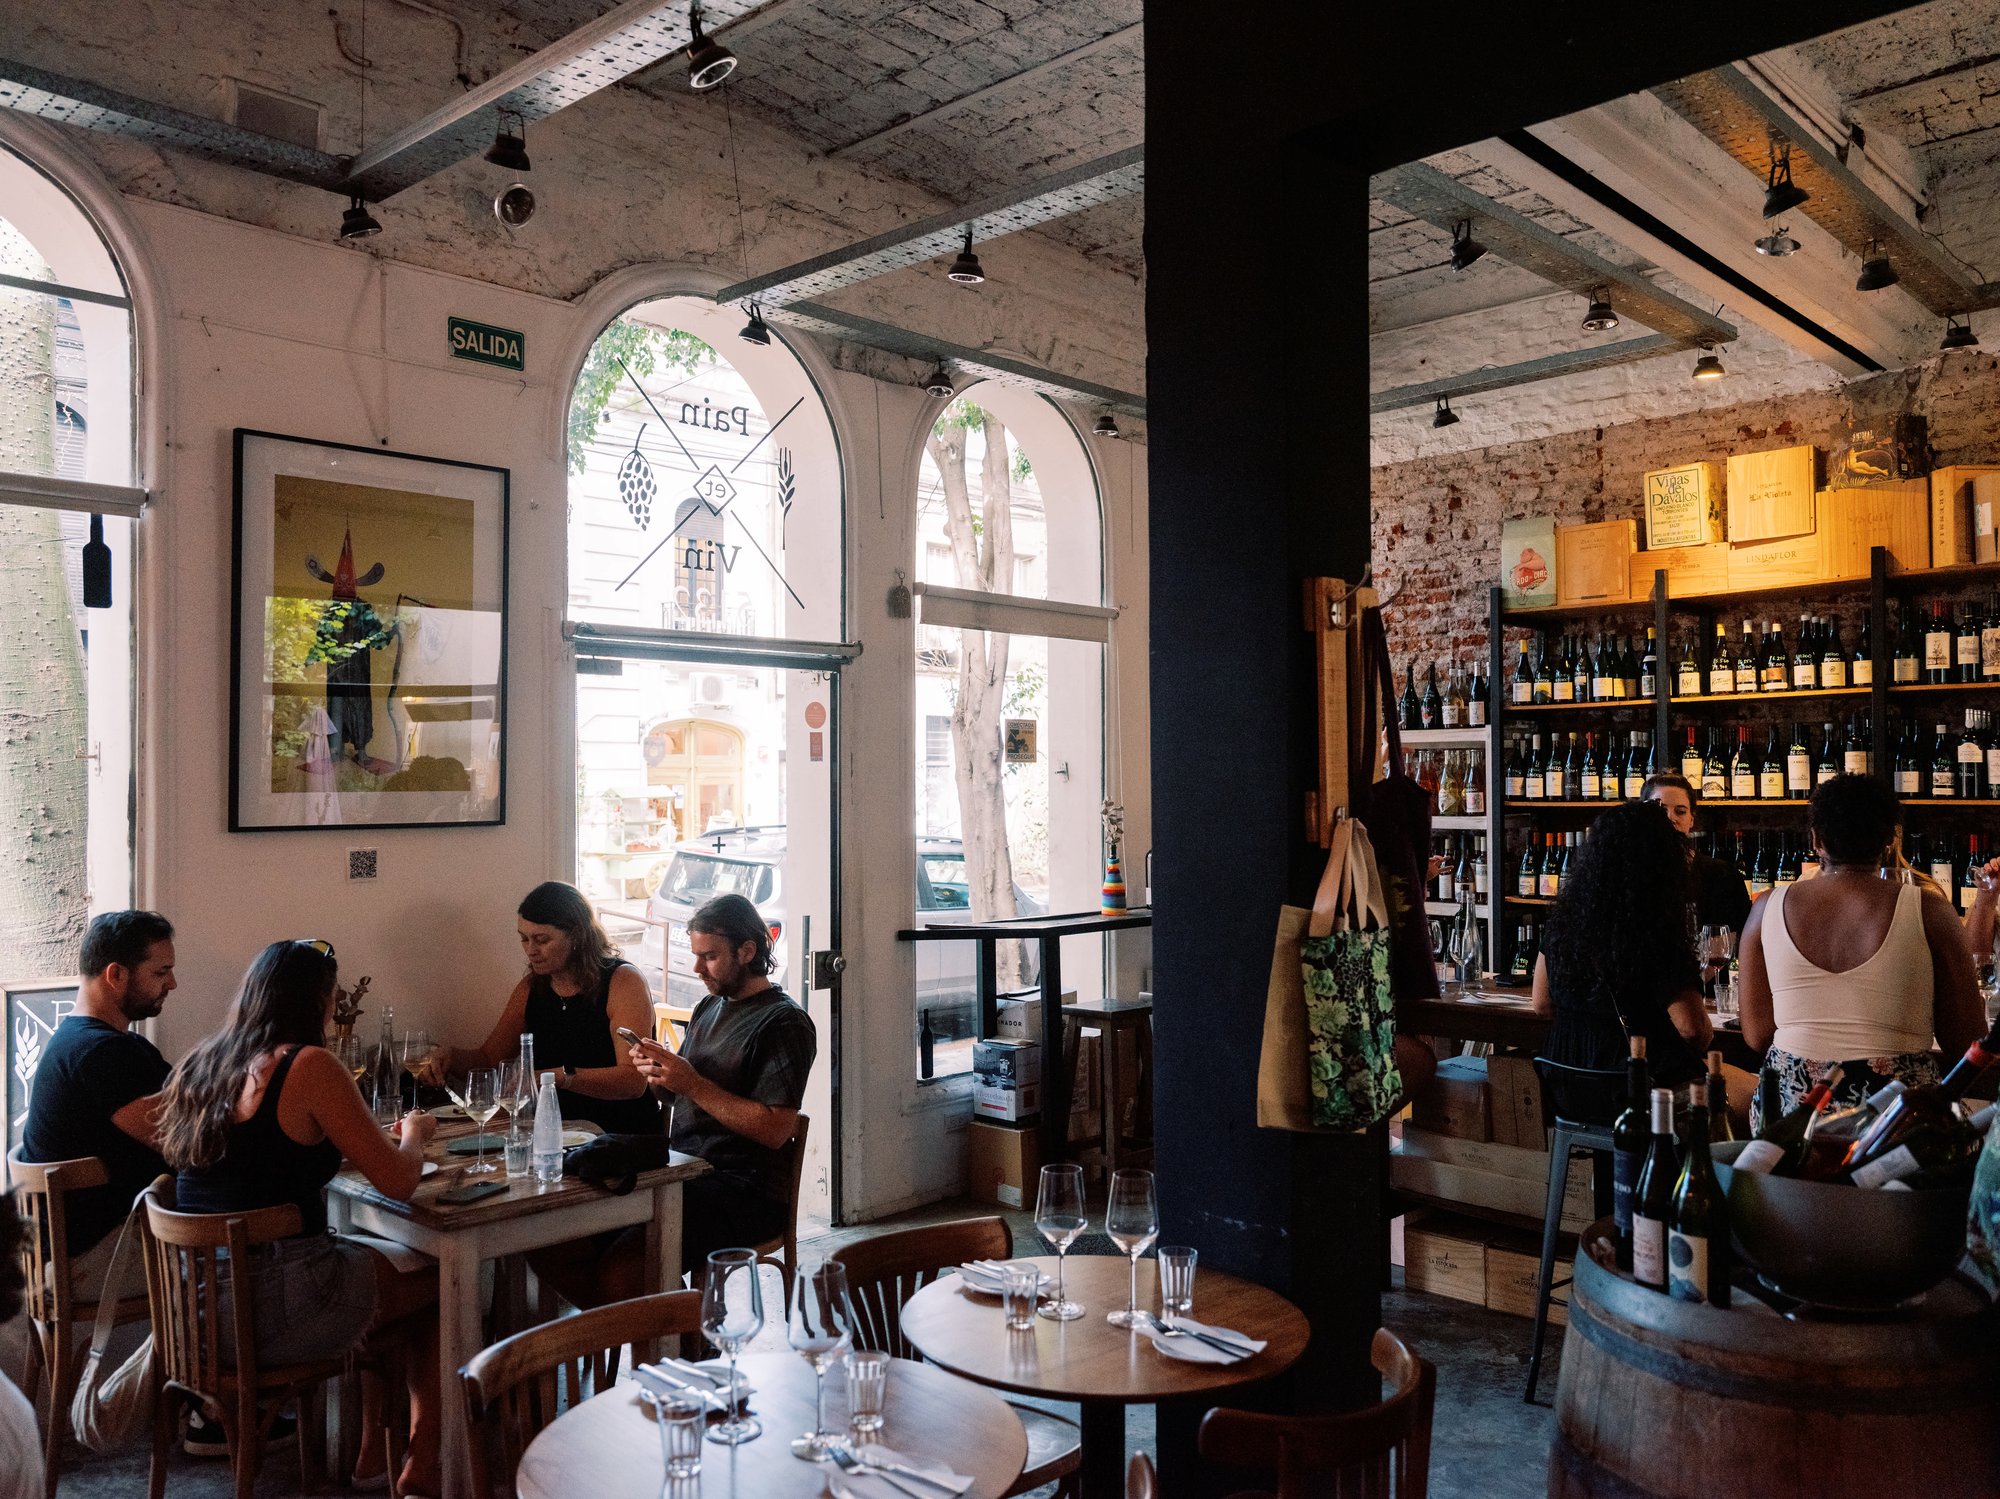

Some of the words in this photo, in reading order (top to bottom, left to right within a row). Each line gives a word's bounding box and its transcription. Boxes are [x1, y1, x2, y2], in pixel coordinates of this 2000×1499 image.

[452, 327, 520, 361] SALIDA
[1656, 474, 1690, 488] Viñas
[1667, 482, 1682, 495] de
[1652, 488, 1698, 507] Dávalos
[1746, 550, 1797, 565] LINDAFLOR
